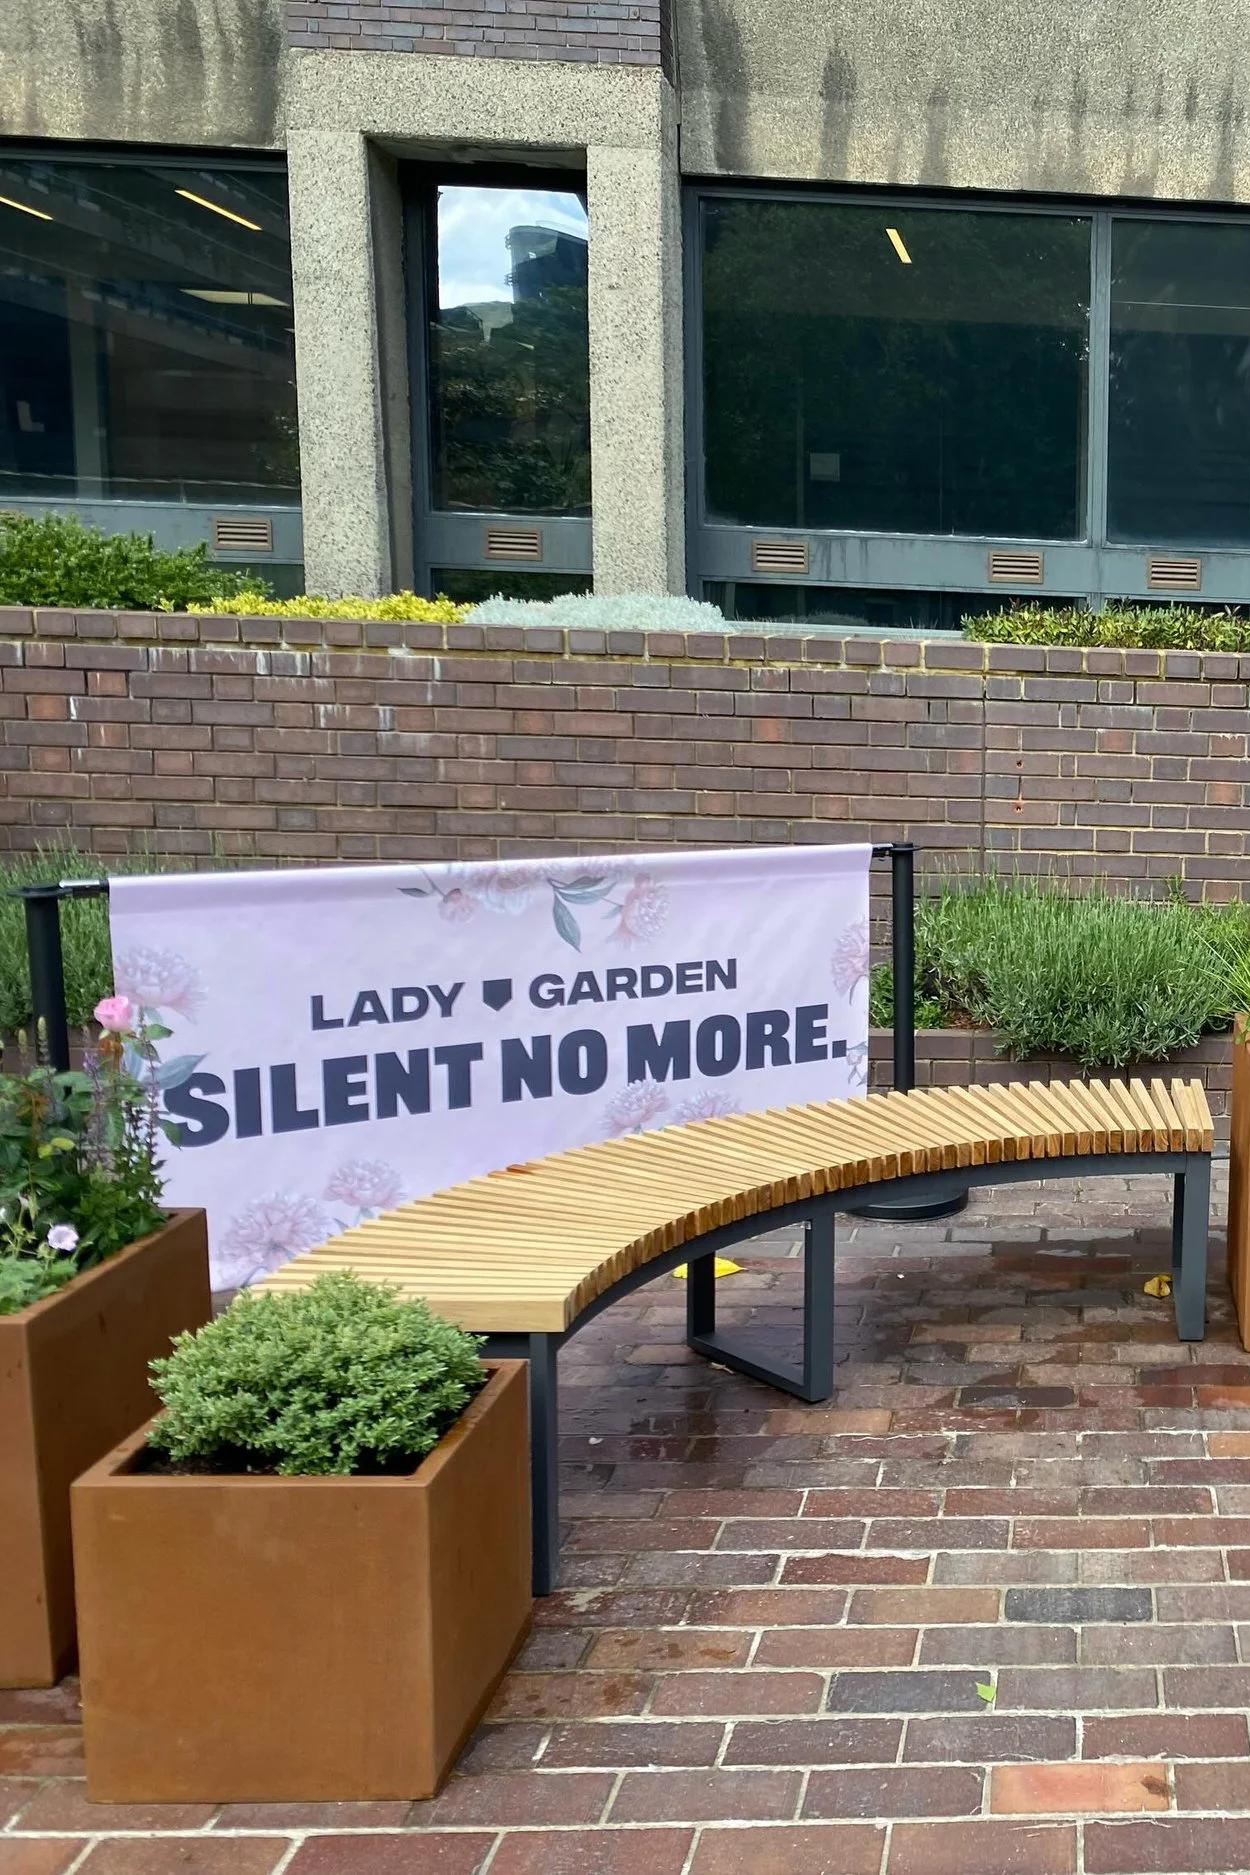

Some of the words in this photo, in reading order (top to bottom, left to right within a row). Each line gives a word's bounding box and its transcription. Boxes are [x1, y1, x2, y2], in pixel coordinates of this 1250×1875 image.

[310, 981, 465, 1031] LADY
[529, 958, 737, 1009] GARDEN
[163, 1042, 484, 1147] SILENT
[500, 1029, 608, 1103] NO
[626, 1003, 847, 1083] MORE.
